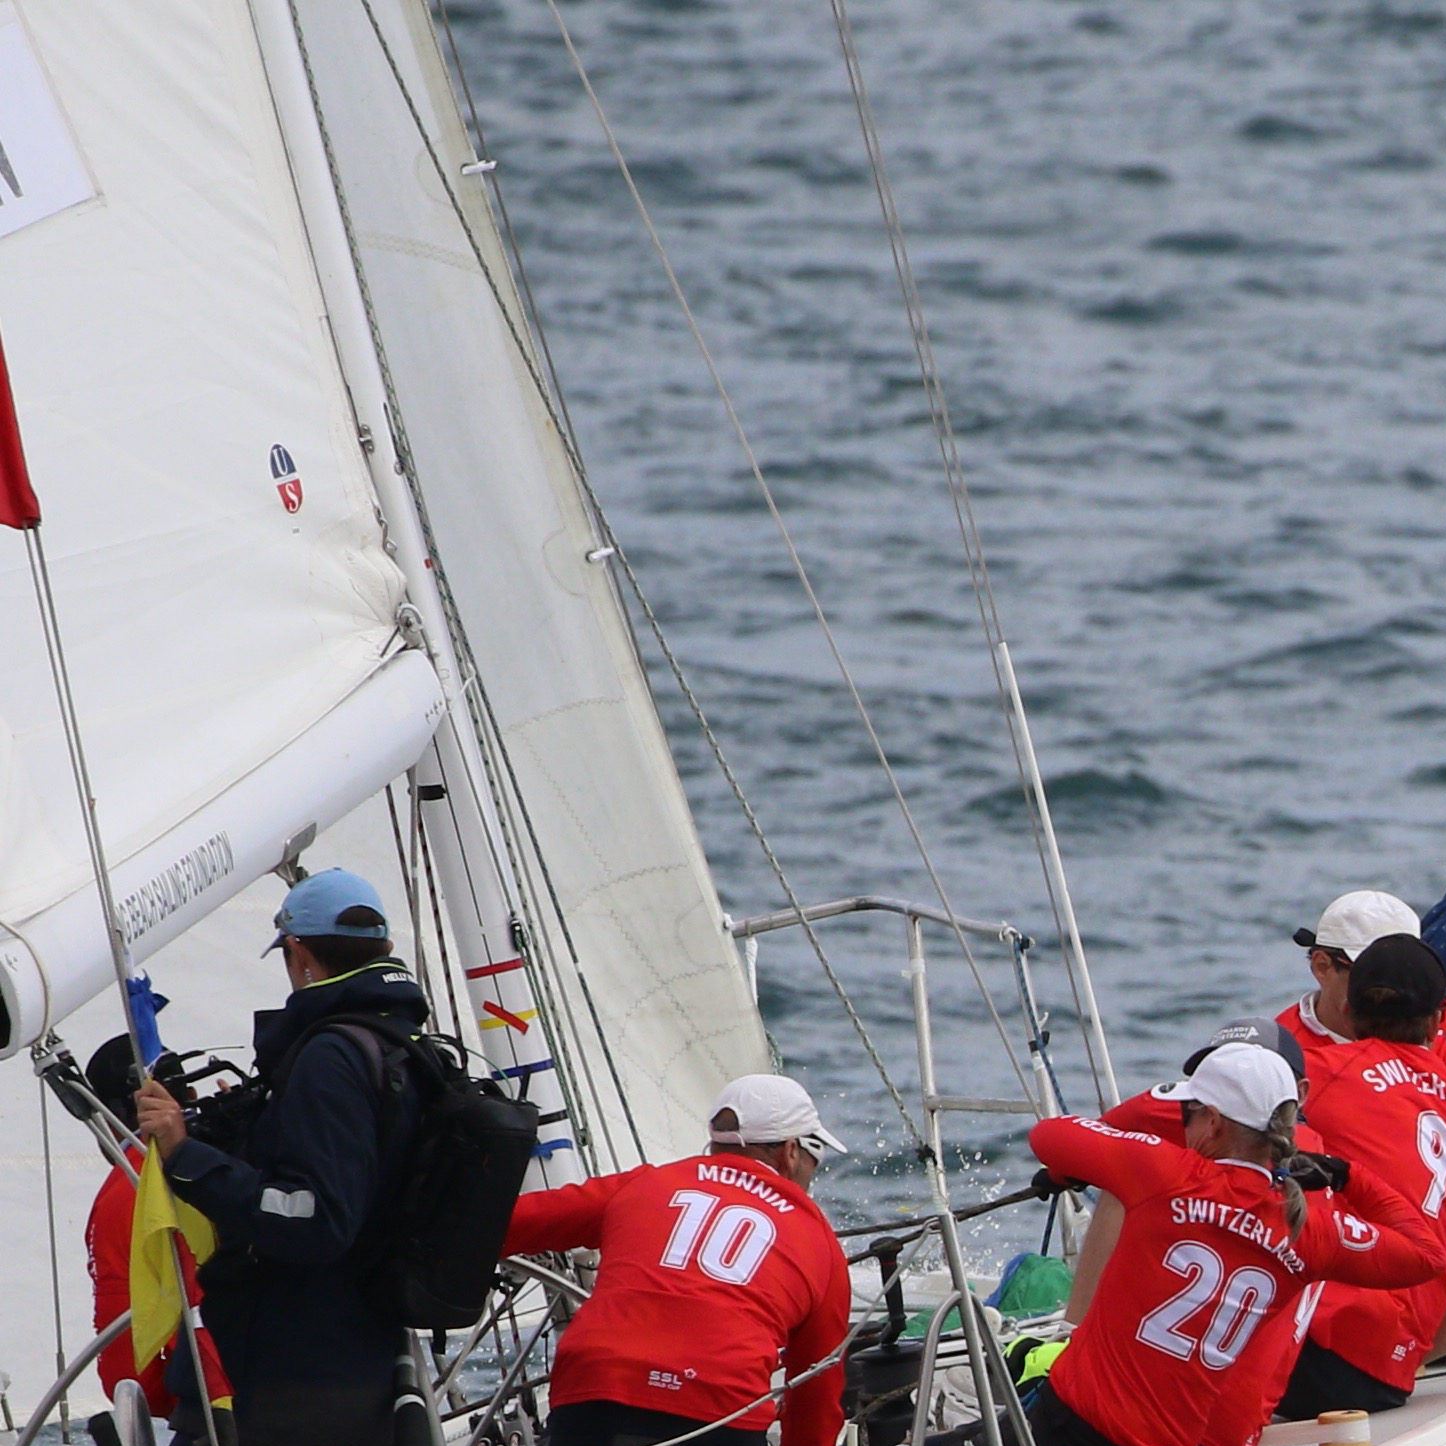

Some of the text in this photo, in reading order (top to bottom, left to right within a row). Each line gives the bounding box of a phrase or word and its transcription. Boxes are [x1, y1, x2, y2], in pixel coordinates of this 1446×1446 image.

[697, 1163, 795, 1215] MONNIN
[659, 1188, 777, 1287] 10
[1136, 1239, 1277, 1371] 20
[649, 1370, 683, 1386] SSL
